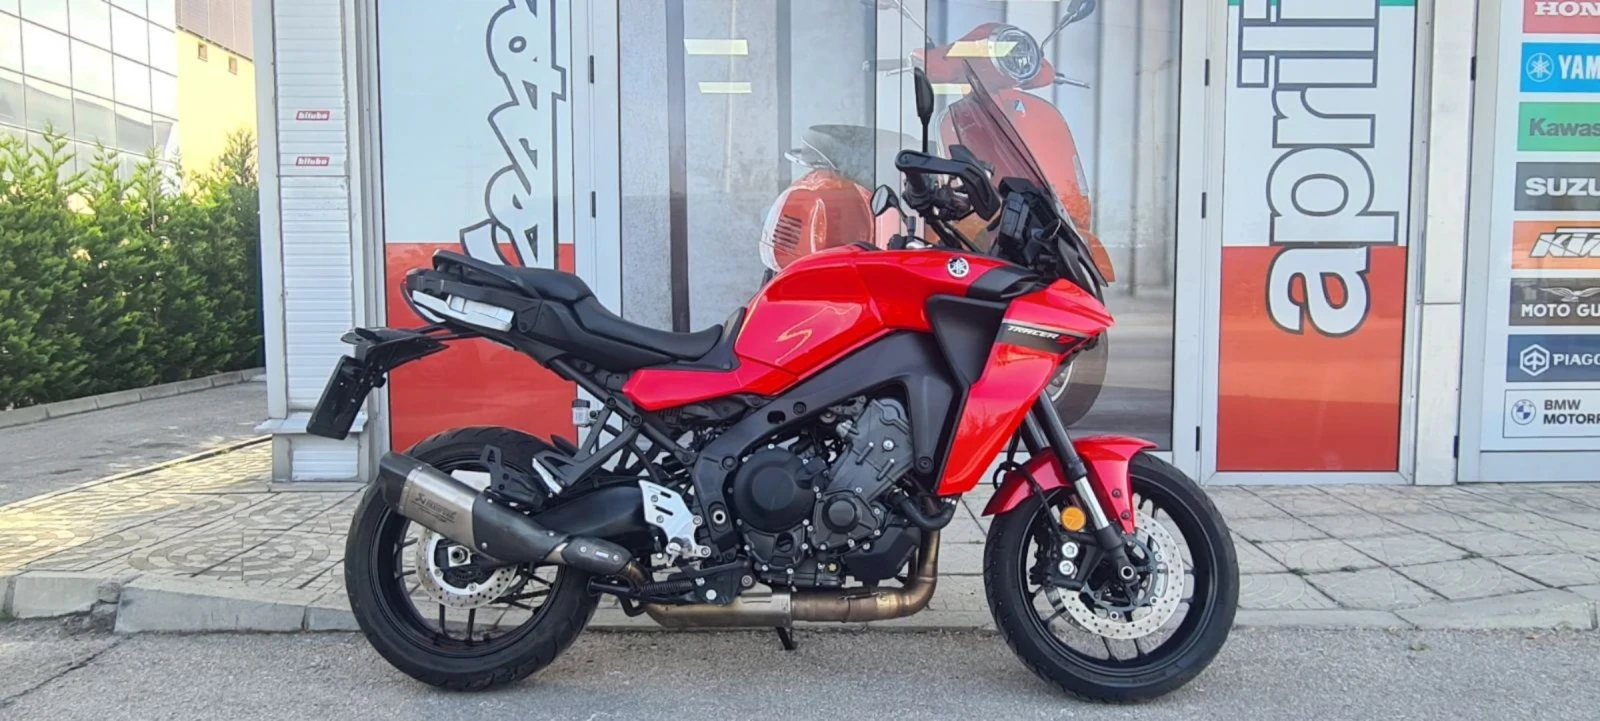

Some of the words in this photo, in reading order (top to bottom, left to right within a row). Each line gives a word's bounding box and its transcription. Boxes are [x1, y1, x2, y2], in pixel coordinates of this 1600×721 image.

[1534, 1, 1600, 17] HON
[1557, 54, 1600, 80] YAM
[460, 0, 566, 268] esp
[1521, 303, 1571, 318] MOTO
[1007, 325, 1060, 339] TRACER
[1544, 399, 1581, 410] BMW
